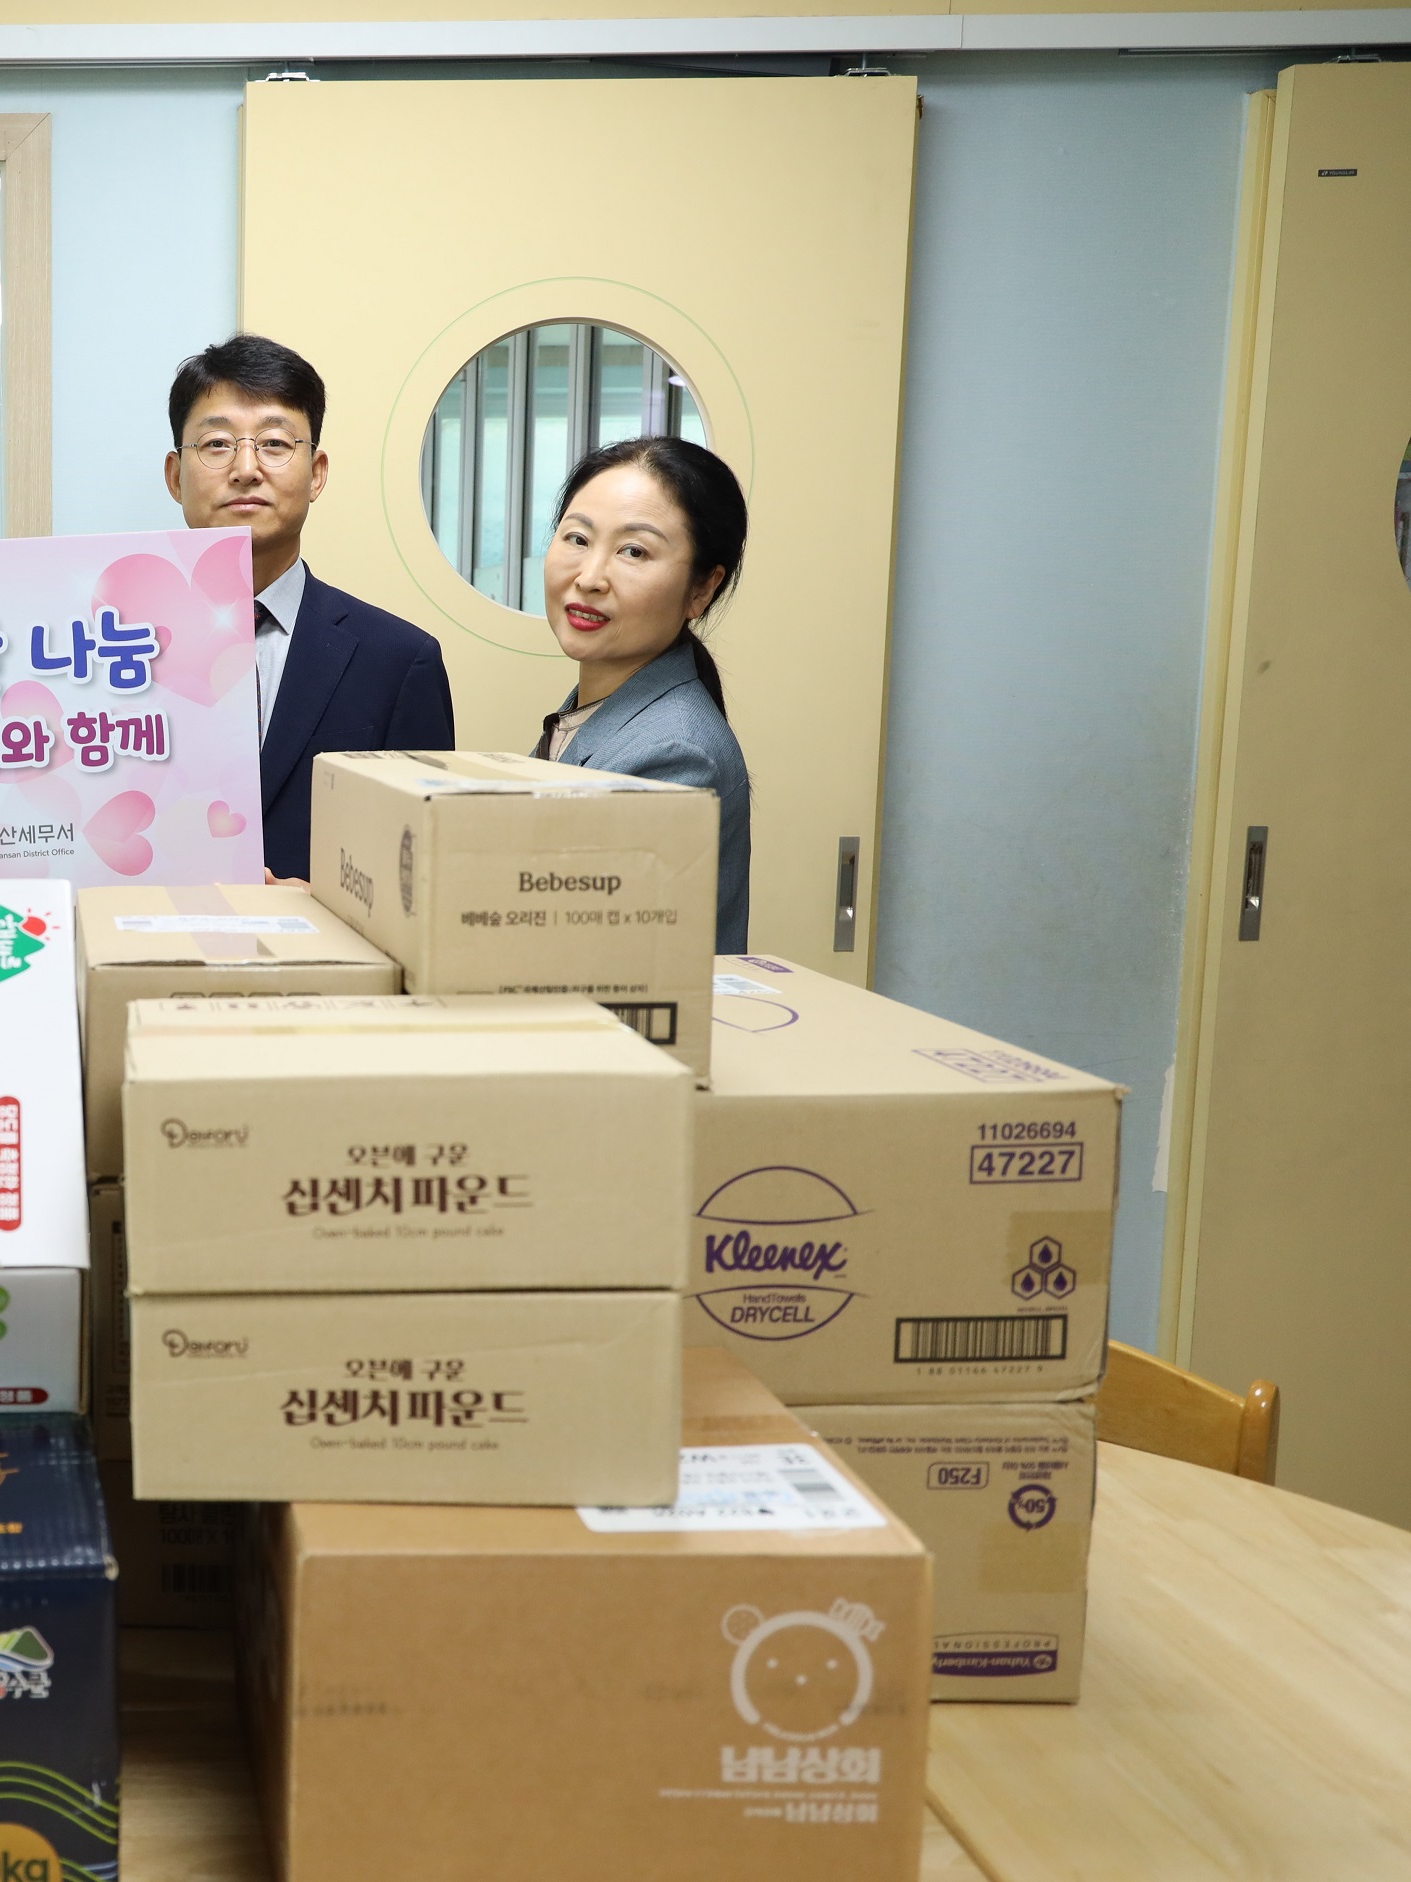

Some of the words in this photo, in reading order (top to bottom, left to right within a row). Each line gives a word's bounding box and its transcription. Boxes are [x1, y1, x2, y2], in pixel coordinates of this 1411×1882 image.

[29, 610, 156, 689] 나눔
[67, 711, 167, 767] 함께
[23, 849, 50, 858] District
[51, 848, 75, 856] Office
[340, 847, 374, 919] Bebesup
[518, 871, 622, 896] Bebesup
[460, 911, 502, 927] 베베숲
[505, 911, 547, 927] 오리진
[635, 910, 678, 926] 10개입
[976, 1121, 1077, 1140] 11026694
[347, 1143, 418, 1168] 오븐에
[425, 1142, 469, 1167] 구운
[977, 1150, 1076, 1177] 47227
[705, 1230, 848, 1281] Kleenex
[730, 1306, 815, 1324] DRYCELL
[344, 1357, 414, 1382] 오븐에
[420, 1357, 466, 1382] 구운
[937, 1467, 982, 1485] F250
